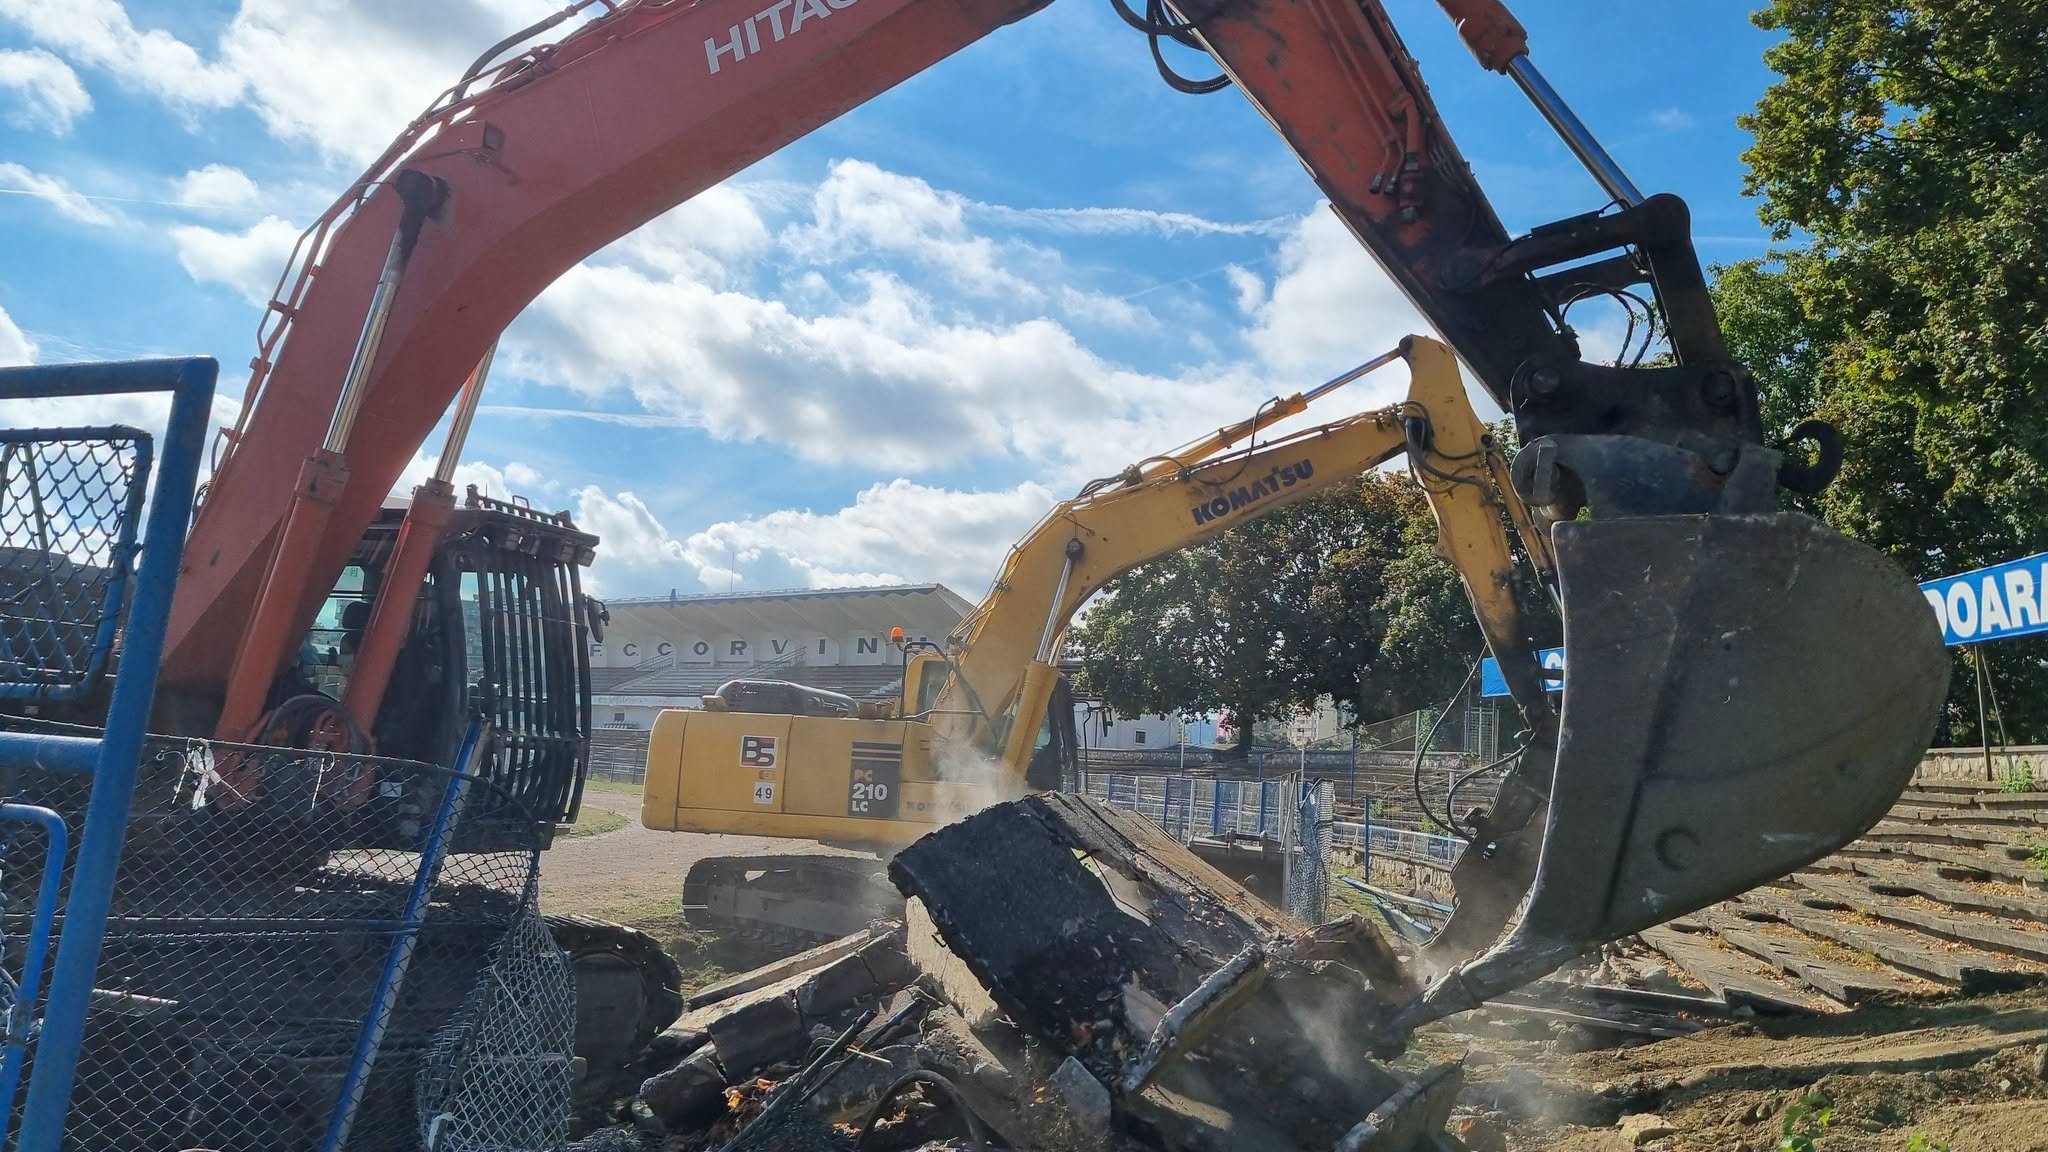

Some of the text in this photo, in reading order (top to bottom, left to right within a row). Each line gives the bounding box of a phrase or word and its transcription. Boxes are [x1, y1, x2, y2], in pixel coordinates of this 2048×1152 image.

[704, 0, 858, 75] HITA
[1191, 458, 1315, 526] KOMATSU
[1922, 562, 2048, 638] DOAR
[755, 787, 772, 799] 49
[851, 800, 868, 813] LC
[852, 782, 888, 801] 210
